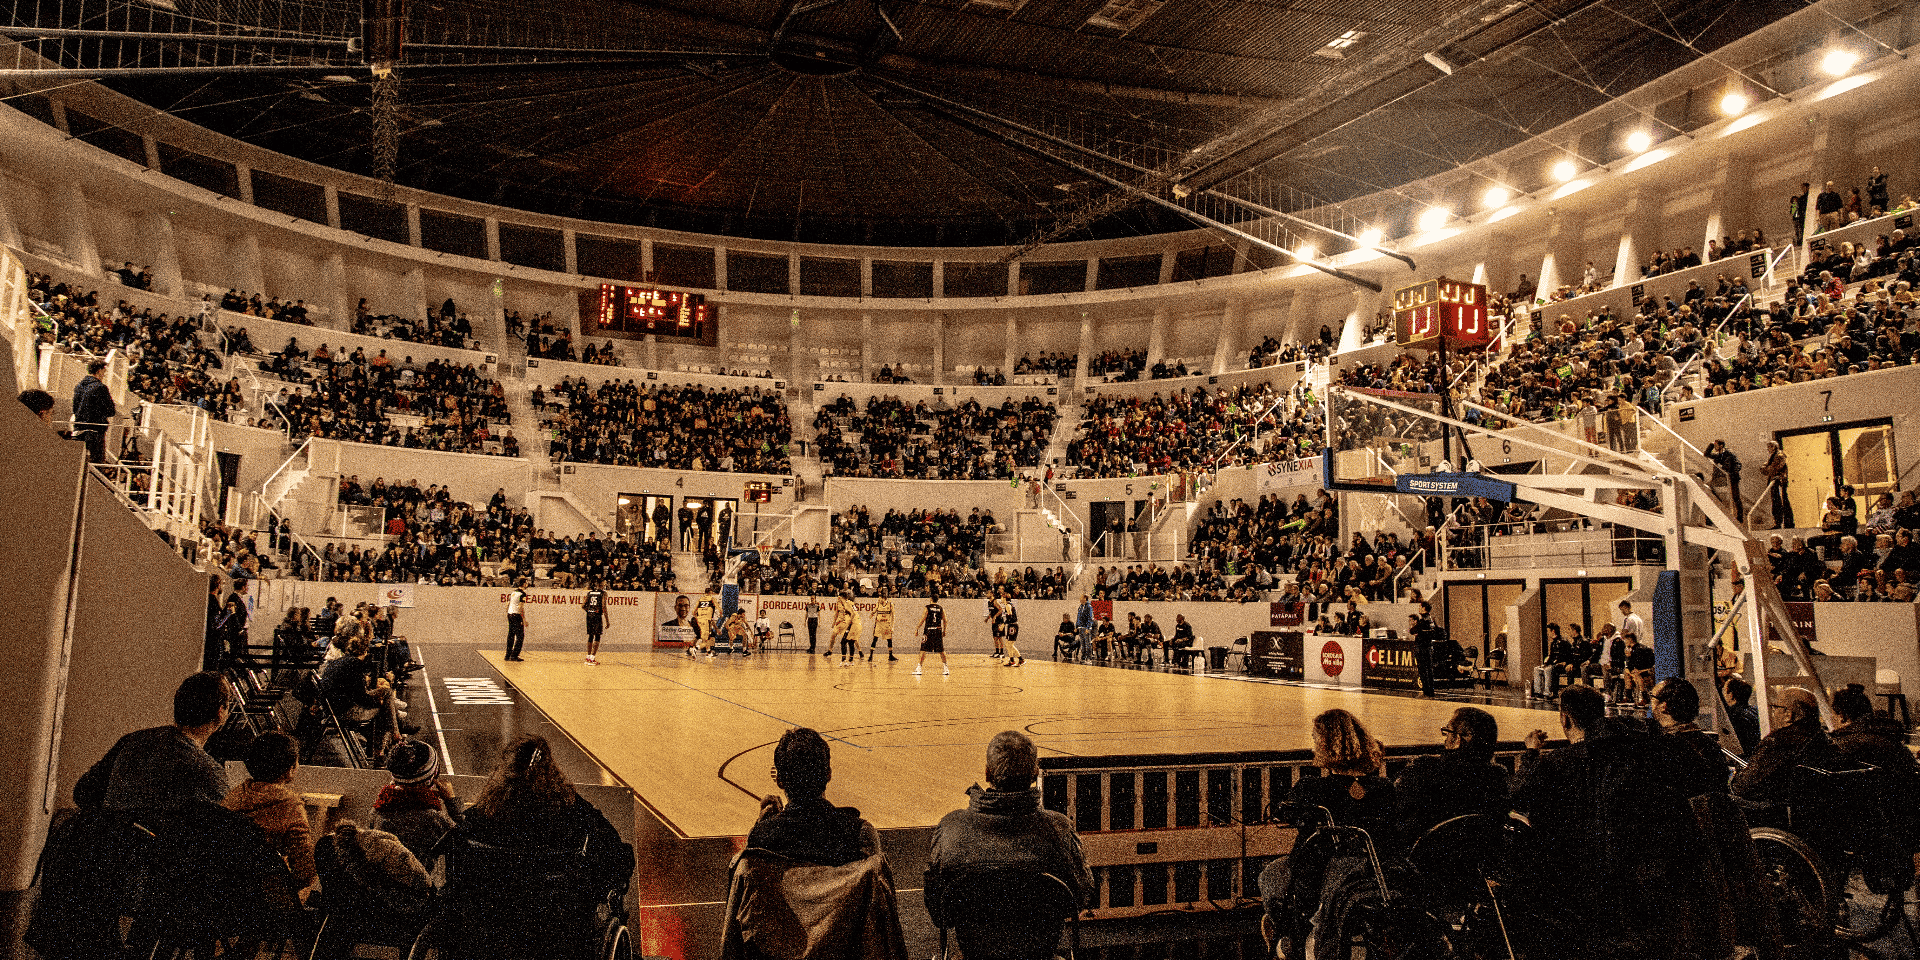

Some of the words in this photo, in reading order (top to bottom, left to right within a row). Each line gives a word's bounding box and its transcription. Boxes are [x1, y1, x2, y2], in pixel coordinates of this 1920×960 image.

[1820, 390, 1832, 411] 7
[1503, 440, 1511, 454] 6
[1276, 459, 1313, 474] SYNEXIA
[676, 477, 683, 488] 4
[1126, 484, 1133, 495] 5
[501, 594, 549, 604] BOEAUX
[553, 595, 566, 604] MA
[763, 601, 808, 610] BORDEAUX
[1369, 649, 1417, 666] CELIM
